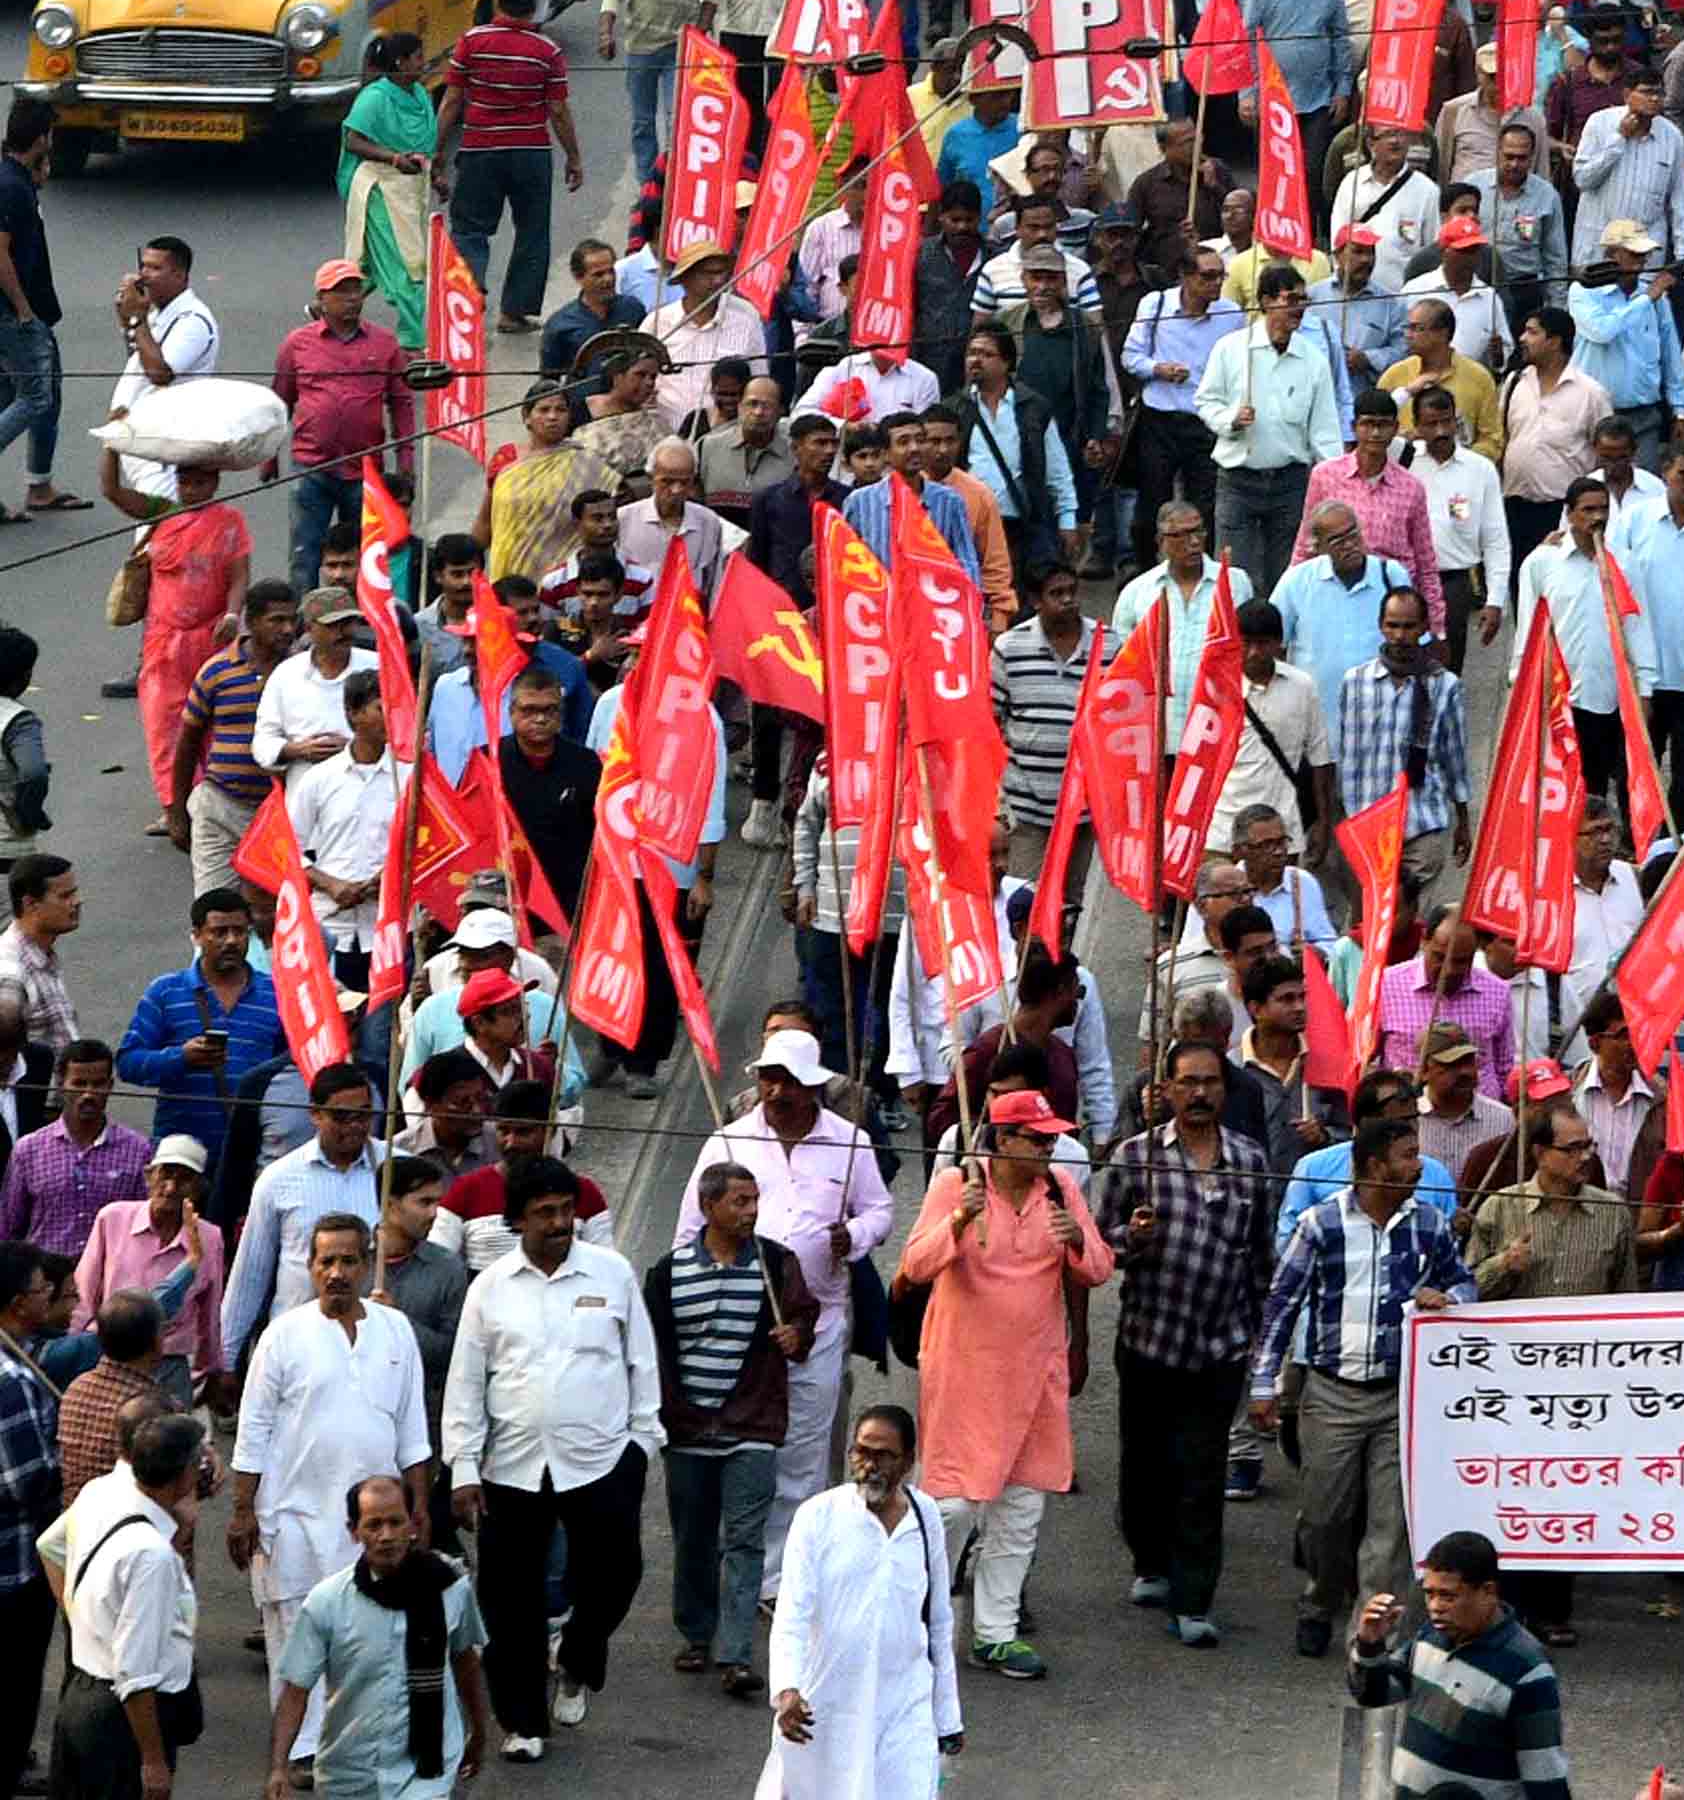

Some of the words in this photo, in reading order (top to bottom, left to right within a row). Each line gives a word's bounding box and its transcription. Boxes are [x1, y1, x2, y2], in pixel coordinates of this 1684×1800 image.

[1428, 1333, 1497, 1372] এই
[1508, 1335, 1684, 1371] জল্লাদের
[1443, 1389, 1513, 1425] এই
[1526, 1390, 1610, 1434] মৃত্যু
[1453, 1452, 1622, 1492] ভারতের
[1493, 1501, 1601, 1548] উত্তর
[1618, 1509, 1676, 1544] ২৪
